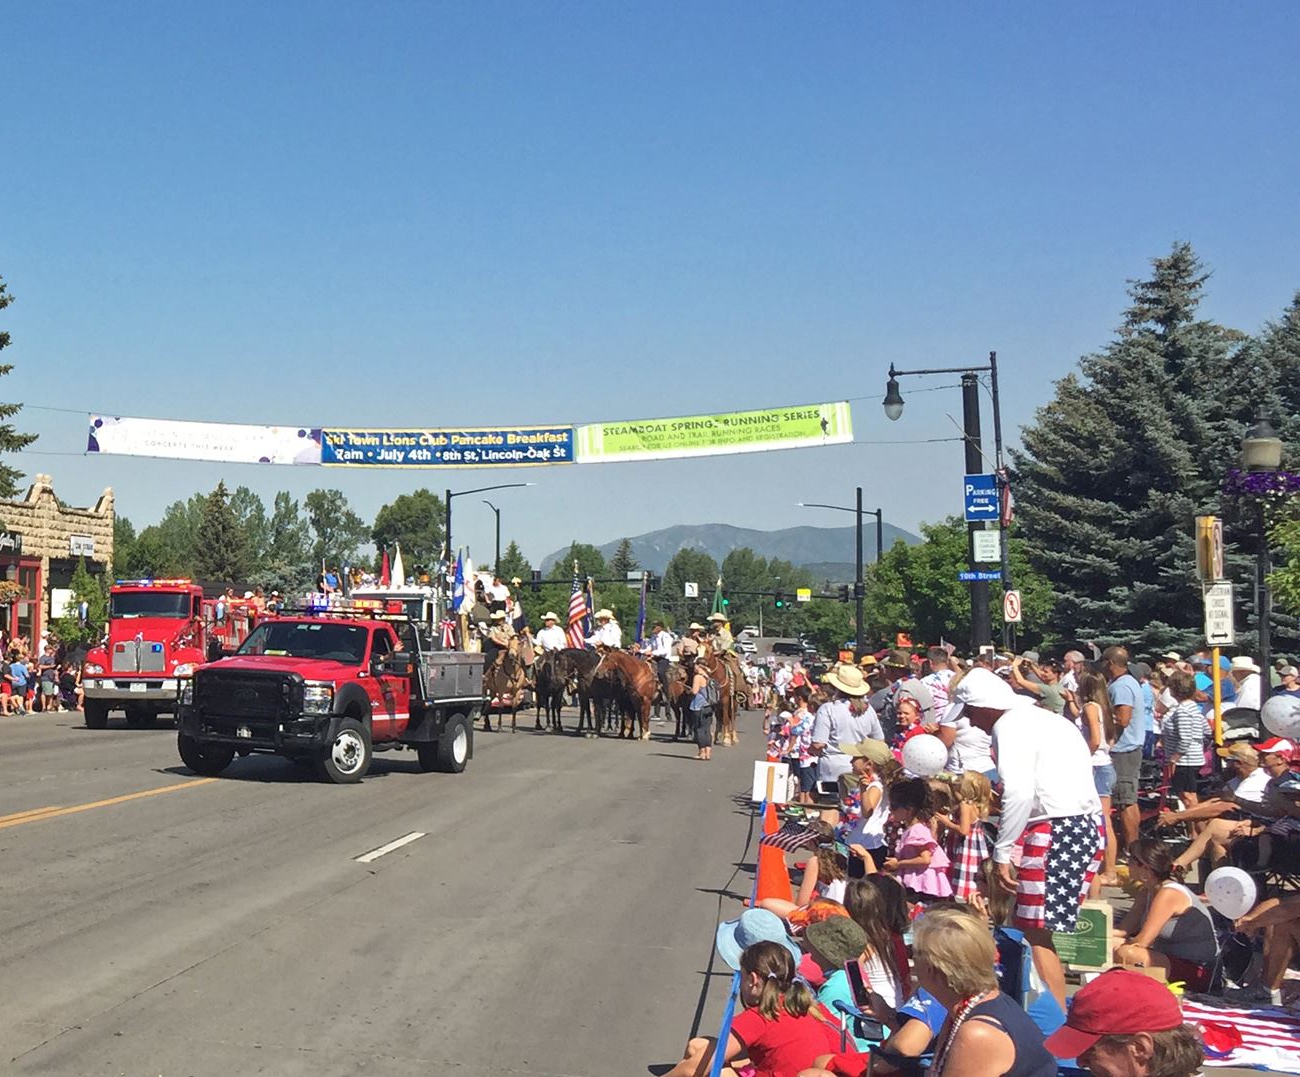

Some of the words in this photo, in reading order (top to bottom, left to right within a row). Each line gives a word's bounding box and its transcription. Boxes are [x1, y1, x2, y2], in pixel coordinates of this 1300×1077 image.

[603, 424, 667, 437] STEAMBOAT
[671, 419, 719, 432] SPRINGS
[723, 414, 779, 427] RUNNING
[783, 409, 820, 422] SERIES
[326, 434, 346, 446] Ski
[348, 434, 380, 446] Town
[383, 434, 416, 446] Lions
[419, 434, 448, 446] Club
[451, 434, 504, 446] Pancake
[507, 431, 569, 445] Breakfast
[641, 434, 665, 443] ROAD
[667, 432, 685, 441] AND
[688, 430, 709, 439] TRAIL
[711, 427, 753, 438] RUNNING
[754, 424, 781, 433] RACES
[717, 436, 735, 445] INFO
[737, 435, 754, 443] AND
[755, 431, 807, 442] REGISTRATION
[336, 448, 364, 460] 7am
[376, 448, 405, 462] July
[407, 448, 431, 460] 4th
[442, 450, 462, 461] 8th
[463, 450, 480, 462] St,
[481, 448, 551, 461] Lincoln-Oak
[553, 447, 567, 458] St
[966, 484, 996, 496] PARKING
[959, 572, 977, 580] 10th
[978, 572, 1001, 580] Street
